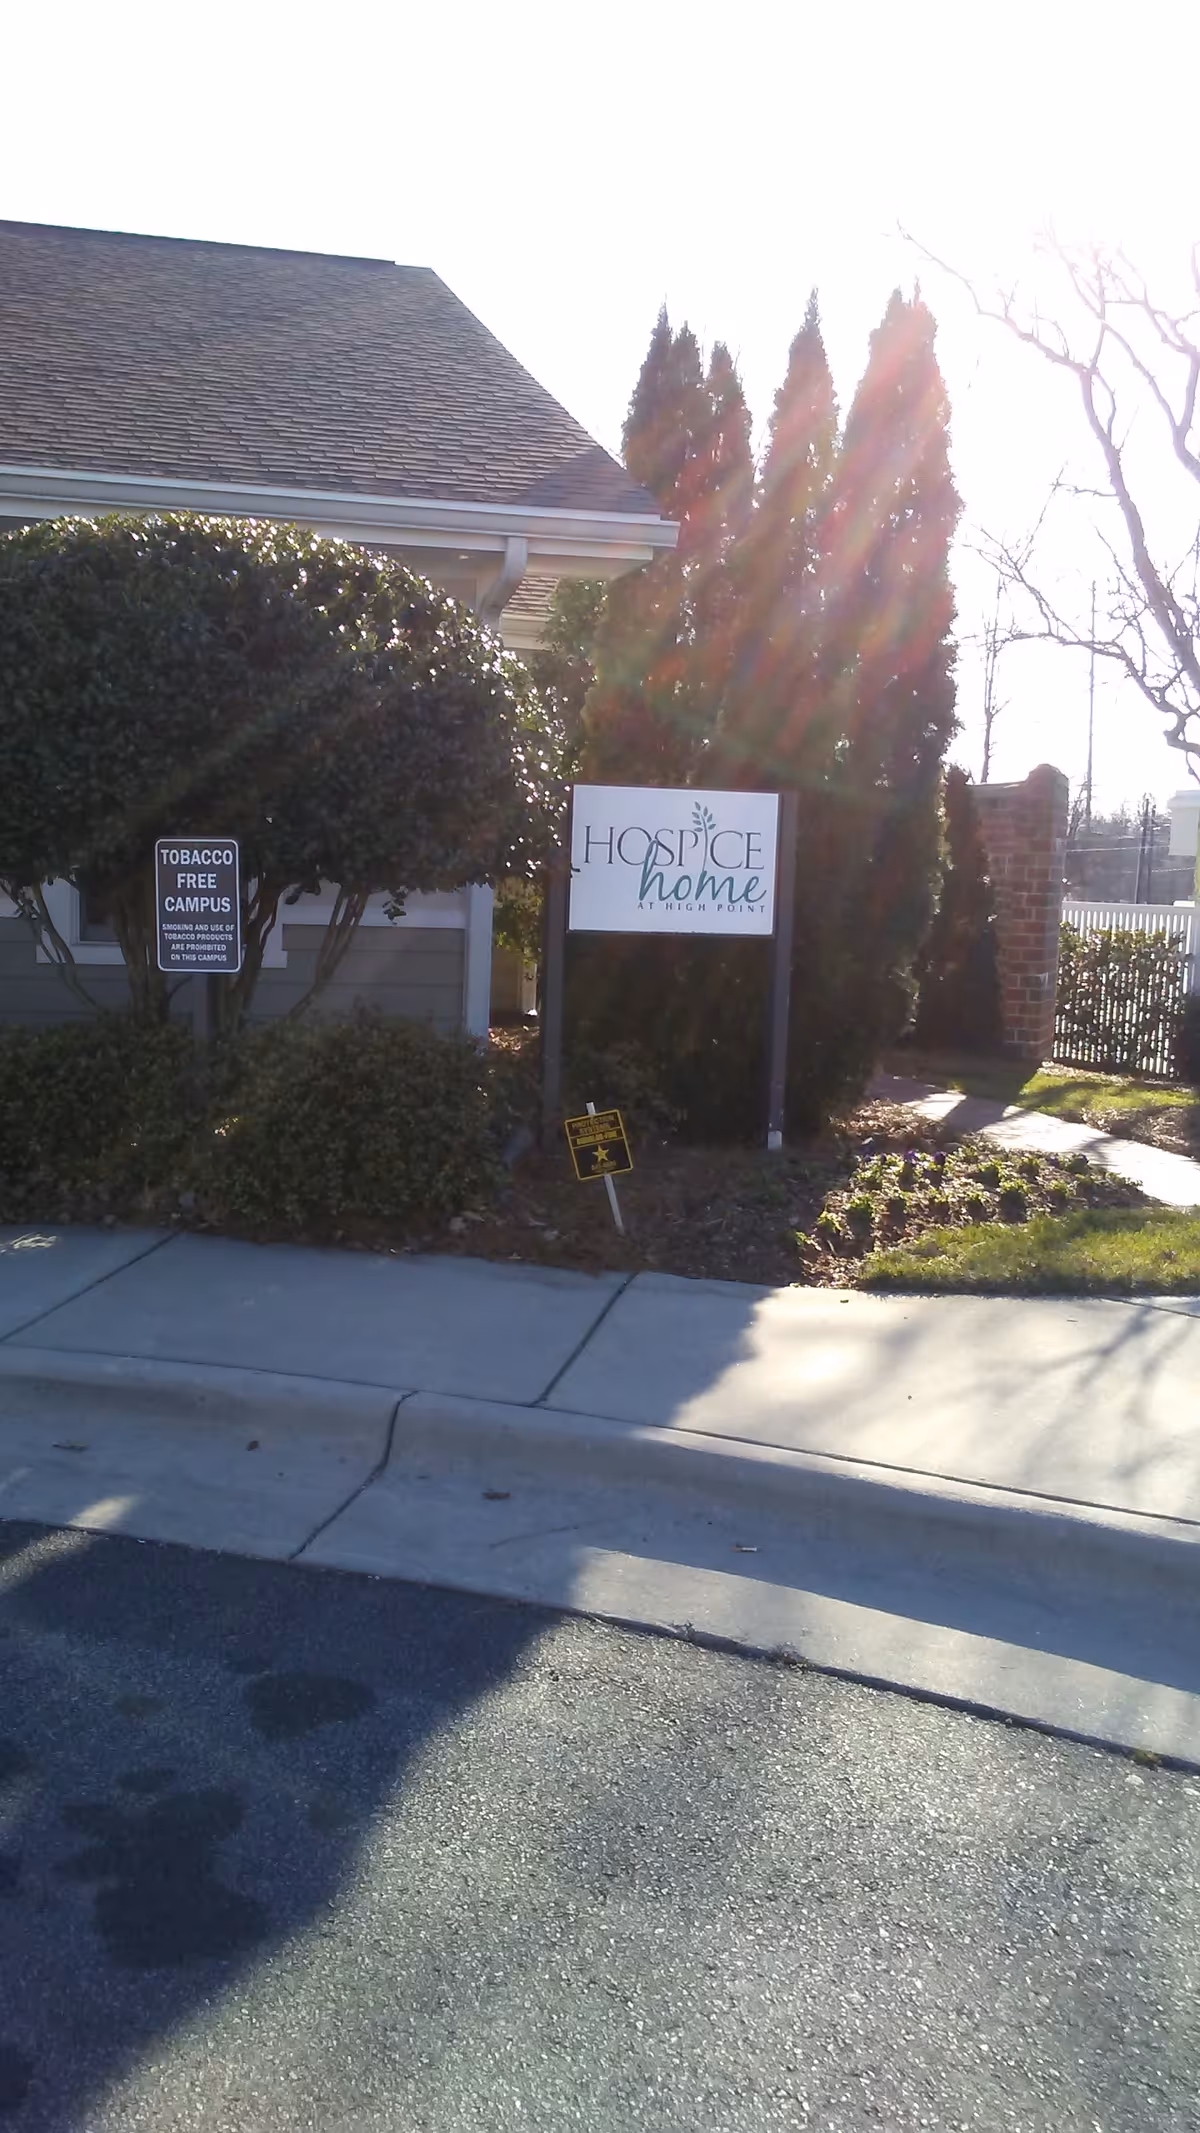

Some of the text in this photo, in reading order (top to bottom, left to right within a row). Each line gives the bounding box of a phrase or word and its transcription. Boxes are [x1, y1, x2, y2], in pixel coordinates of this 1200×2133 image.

[584, 824, 765, 871] HOSPICE
[160, 849, 233, 865] TOBACCO
[638, 839, 767, 904] home
[177, 873, 217, 889] FREE
[164, 896, 231, 912] CAMPUS
[637, 901, 765, 913] AT HIGH POINT
[162, 923, 193, 931] SMOKING
[210, 924, 224, 932] USE
[225, 924, 235, 932] OF
[164, 932, 233, 941] TOBACCO PRODUCTS
[171, 943, 227, 952] ARE PROHIBITED
[182, 953, 197, 961] THIS
[198, 953, 227, 962] CAMPUS
